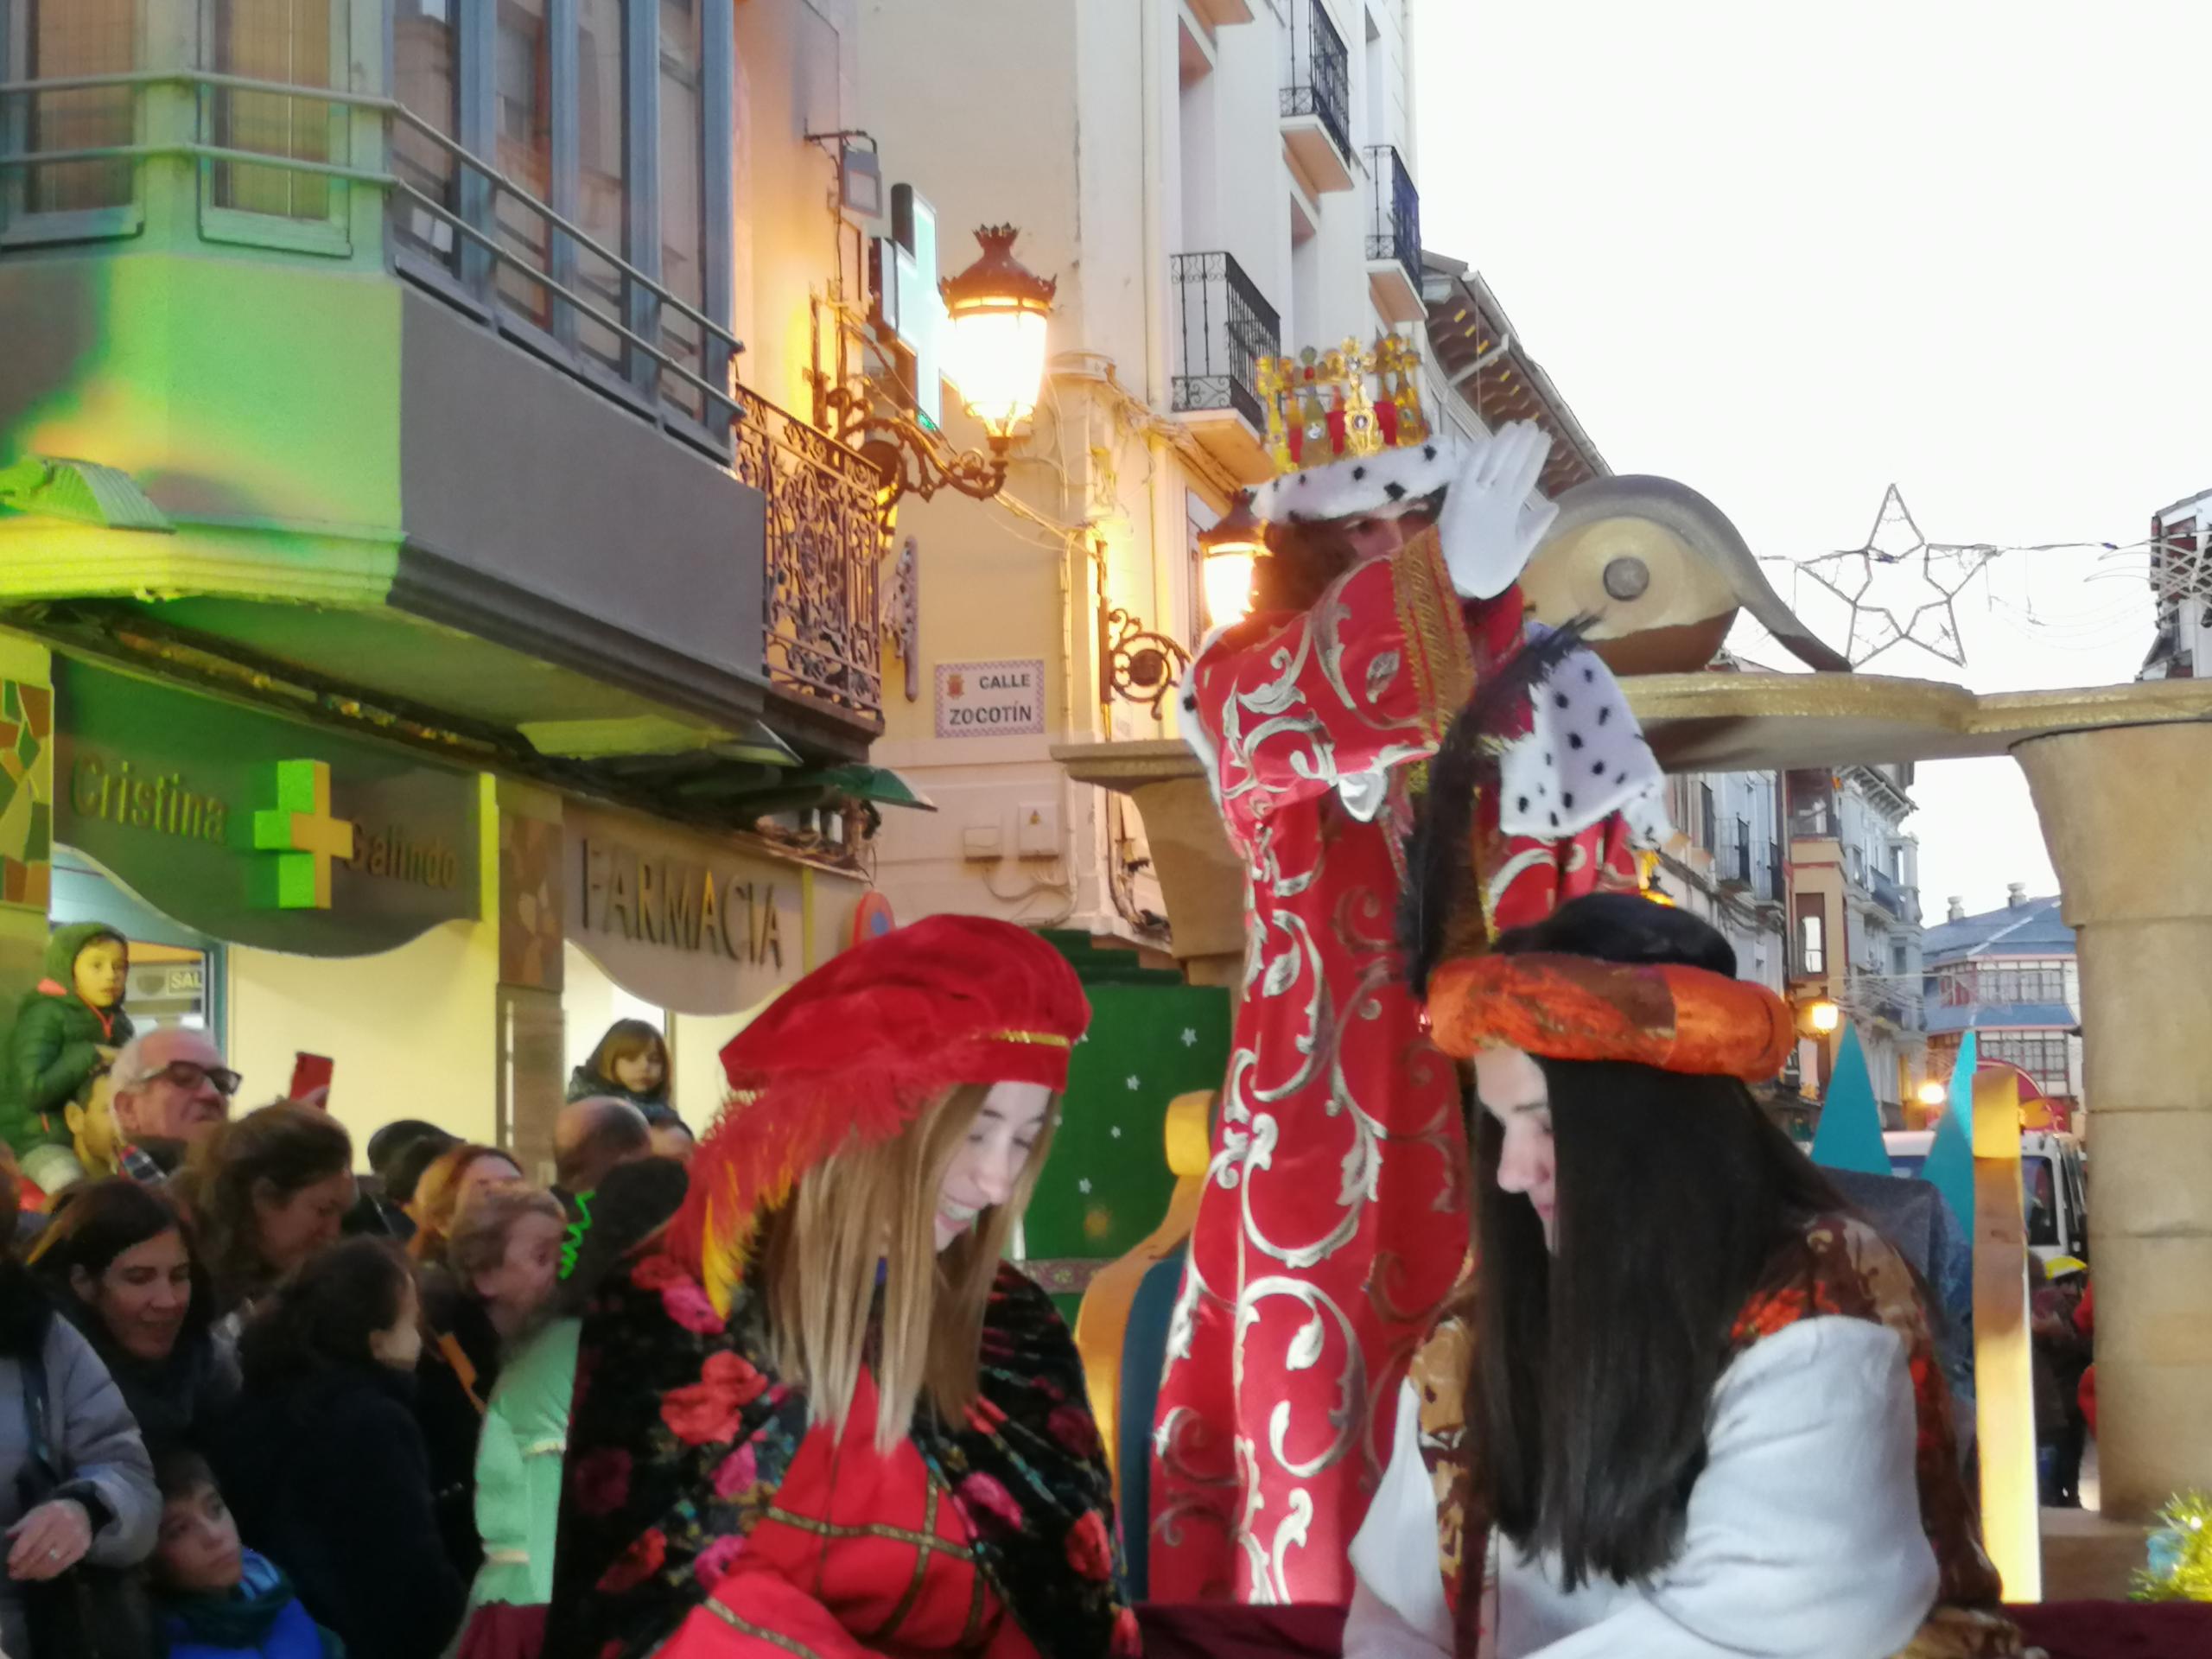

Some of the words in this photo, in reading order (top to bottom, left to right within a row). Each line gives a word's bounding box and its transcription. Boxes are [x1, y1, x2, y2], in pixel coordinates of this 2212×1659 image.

[979, 674, 1031, 690] CALLE
[949, 701, 1032, 726] ZOCOTÍN
[72, 752, 228, 844] Cristina
[581, 837, 783, 971] FARMACIA
